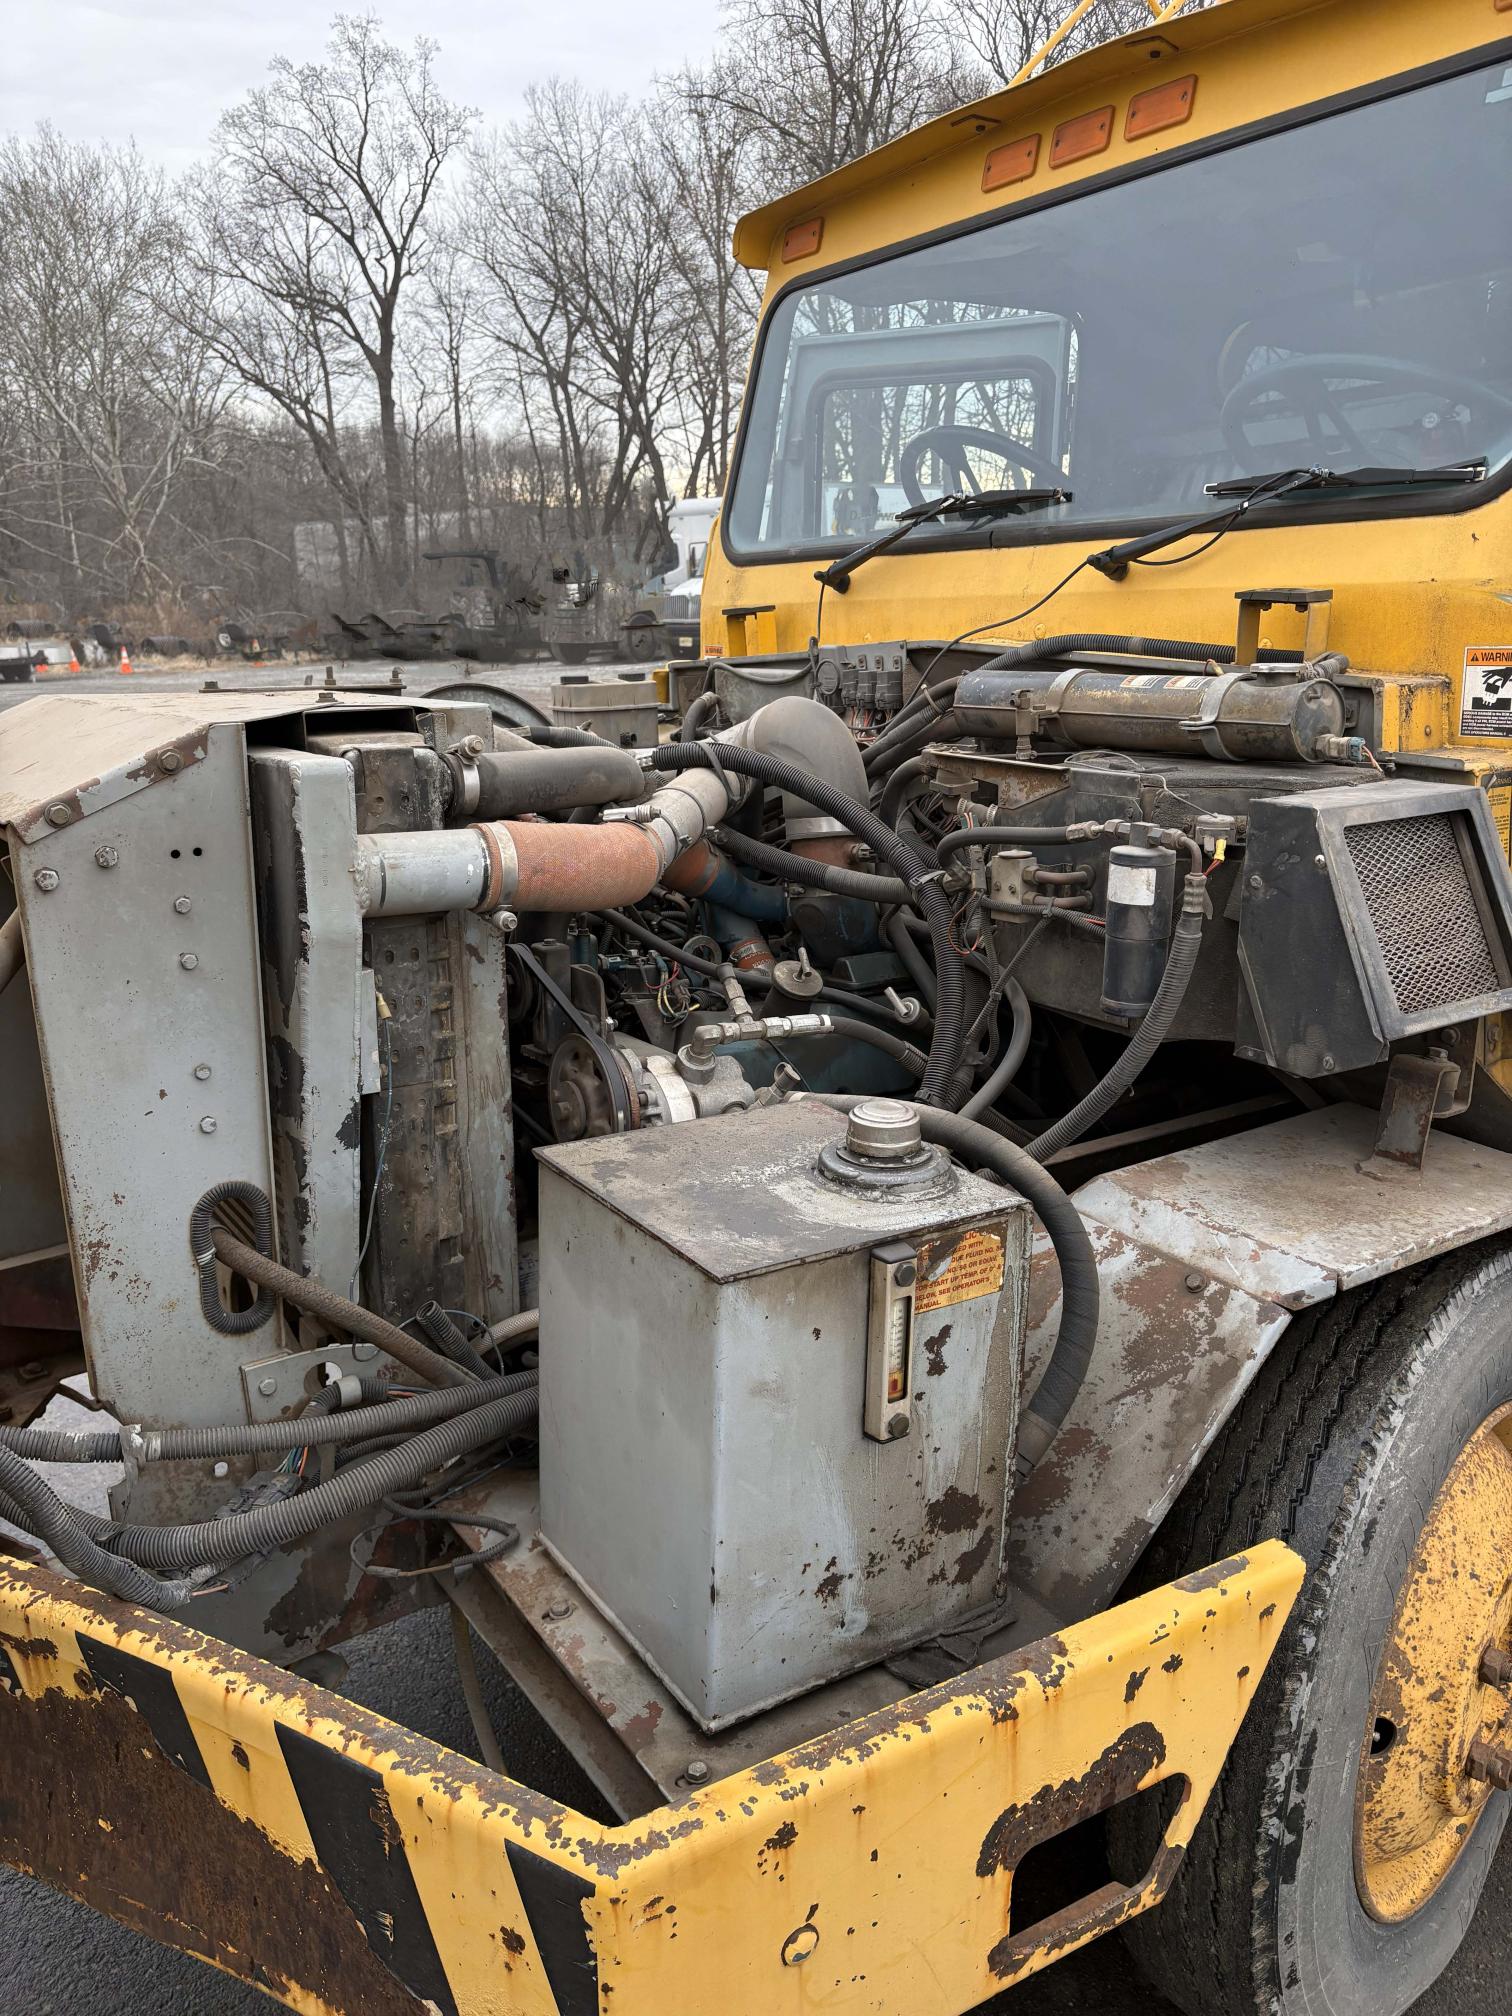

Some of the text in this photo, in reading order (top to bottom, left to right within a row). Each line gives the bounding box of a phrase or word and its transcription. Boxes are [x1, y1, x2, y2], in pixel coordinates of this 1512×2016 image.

[968, 1239, 984, 1250] WITH
[966, 1249, 983, 1260] FLUID
[968, 1260, 978, 1268] OR
[928, 1278, 950, 1289] START
[950, 1275, 960, 1283] UP
[979, 1267, 989, 1275] OF
[938, 1287, 951, 1295] SEE
